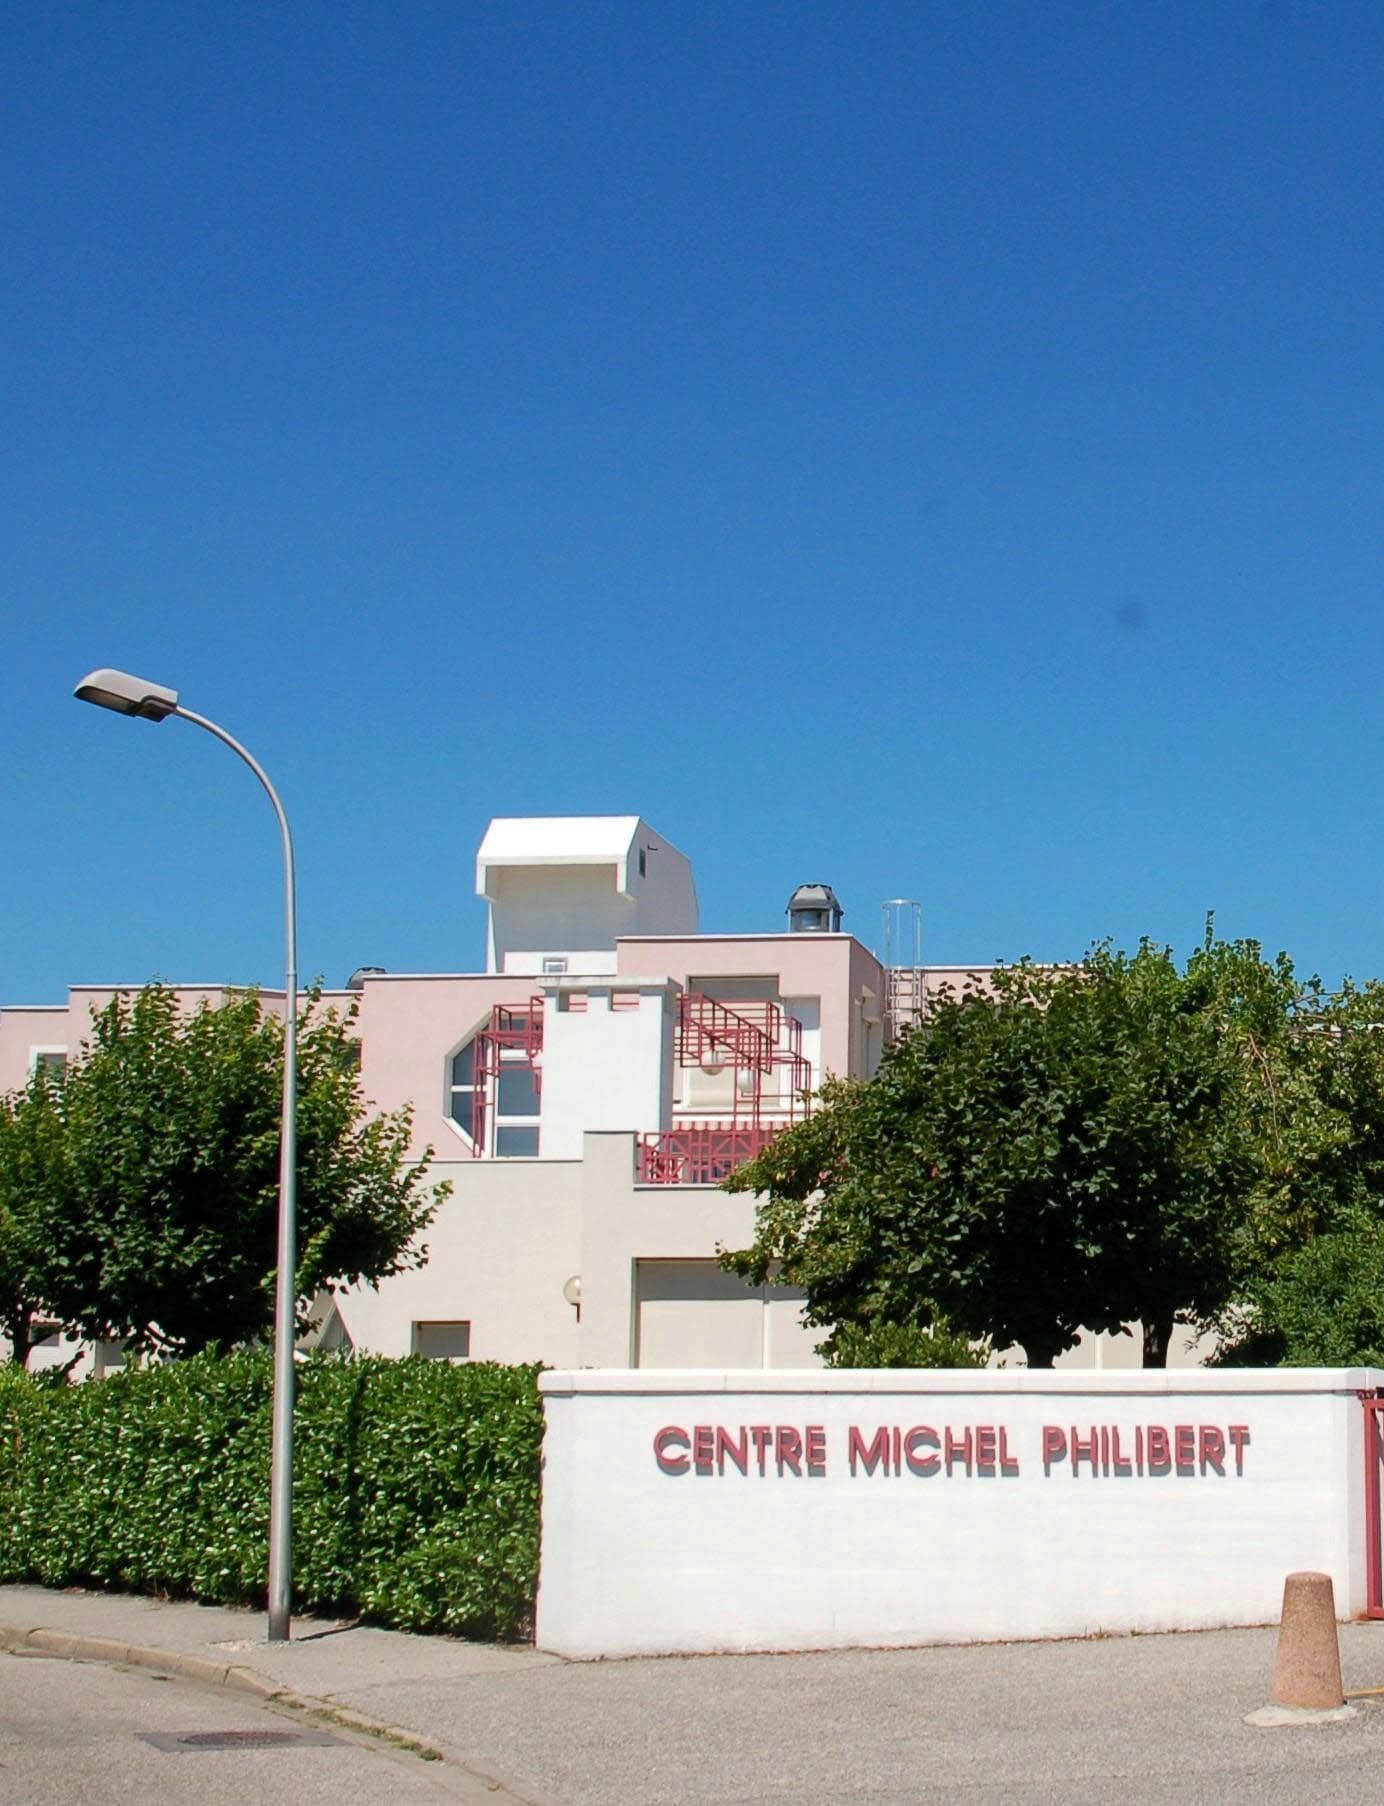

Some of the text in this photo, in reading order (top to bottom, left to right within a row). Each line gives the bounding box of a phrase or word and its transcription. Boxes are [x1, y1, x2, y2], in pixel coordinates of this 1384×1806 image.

[654, 1425, 1250, 1470] CENTRE MICHEL PHILIBERT
